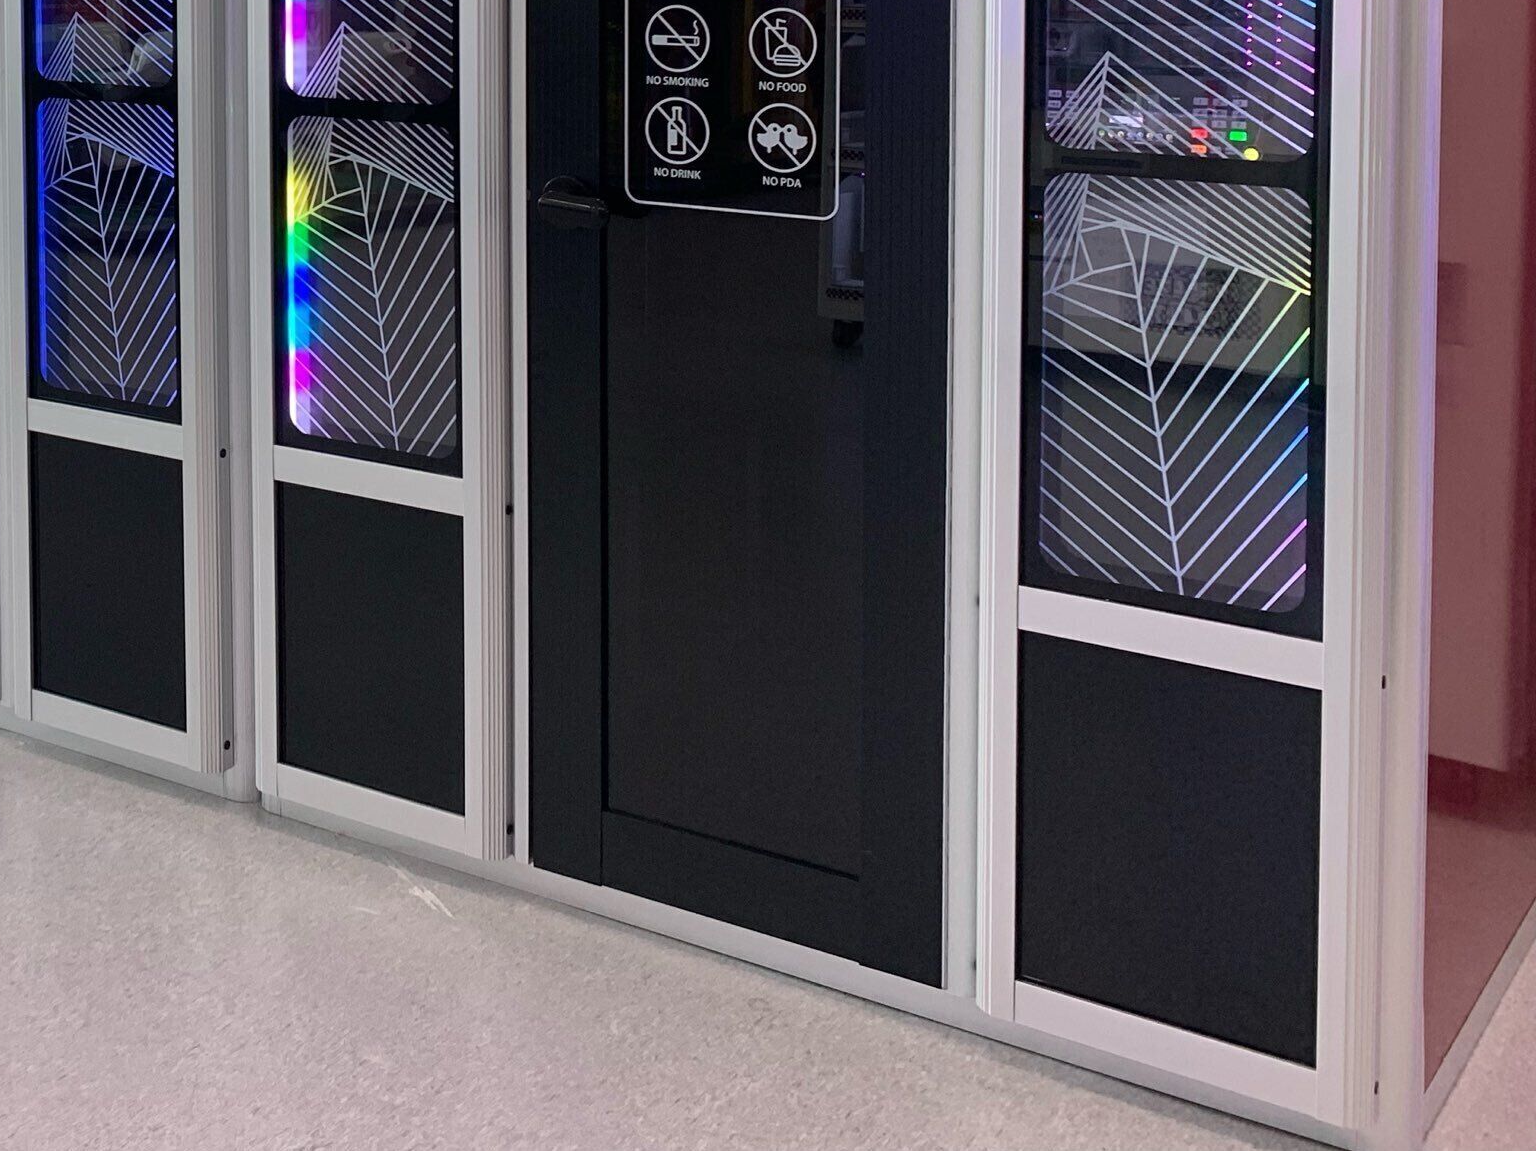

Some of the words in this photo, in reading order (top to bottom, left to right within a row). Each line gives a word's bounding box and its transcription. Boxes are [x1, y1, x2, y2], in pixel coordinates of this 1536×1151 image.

[646, 75, 662, 86] NO
[663, 76, 709, 88] SMOKING
[758, 81, 774, 92] NO
[776, 81, 807, 93] FOOD
[653, 167, 669, 178] NO
[670, 168, 701, 180] DRINK
[762, 176, 779, 187] NO
[780, 177, 802, 188] PDA
